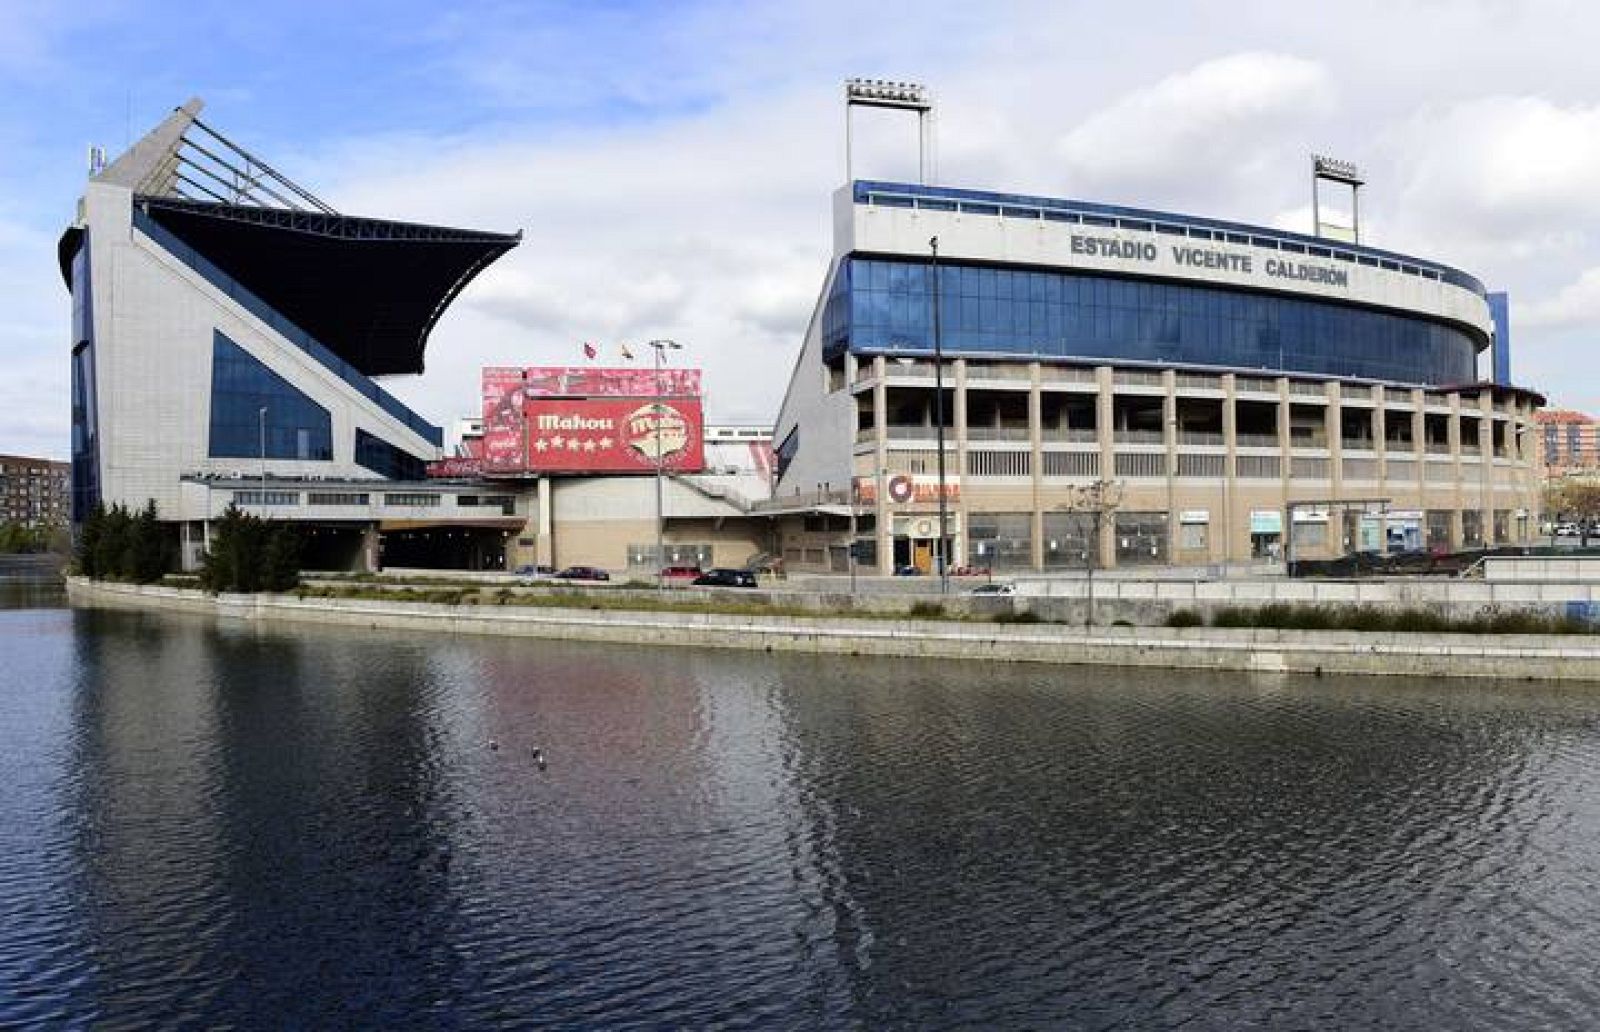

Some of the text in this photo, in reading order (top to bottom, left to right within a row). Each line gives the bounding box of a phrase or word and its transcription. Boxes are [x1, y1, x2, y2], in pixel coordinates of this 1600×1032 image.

[1071, 235, 1348, 287] ESTADIO VICENTE CALDERÓN
[538, 413, 614, 430] Mahou
